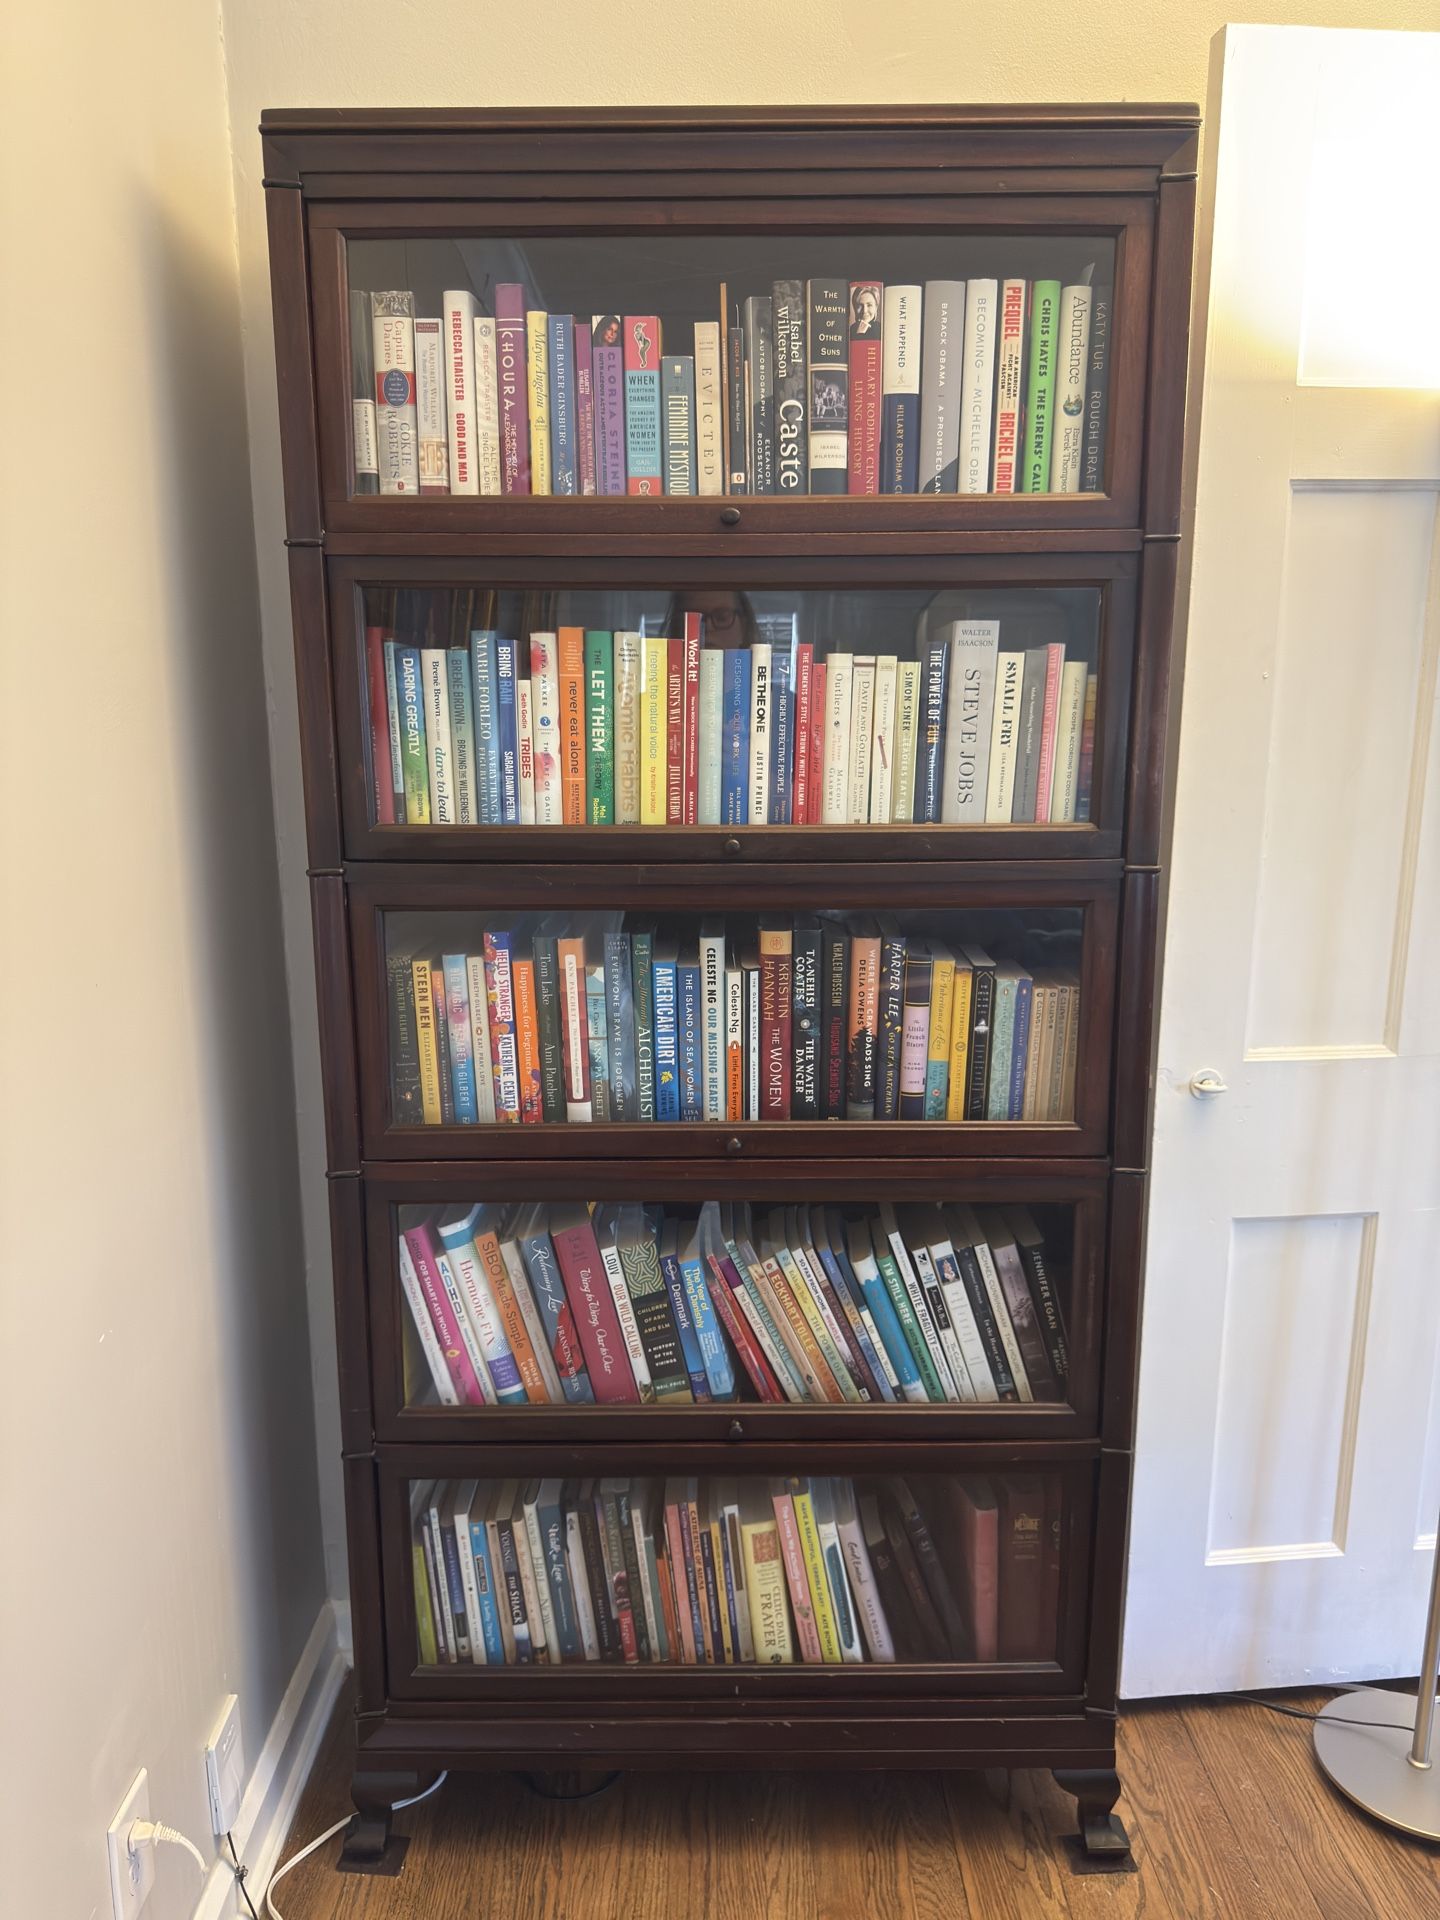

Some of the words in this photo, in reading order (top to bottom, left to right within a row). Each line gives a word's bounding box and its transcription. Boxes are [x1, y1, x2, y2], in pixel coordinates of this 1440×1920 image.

[815, 305, 846, 313] WARMTH
[824, 290, 838, 299] THE
[940, 303, 948, 344] BARACK
[1004, 287, 1022, 340] PREQUEL
[1041, 299, 1051, 335] CHRIS
[1096, 302, 1107, 335] KATY
[383, 322, 392, 365] Dames
[394, 320, 406, 365] Capital
[452, 311, 463, 354] REBECCA
[556, 323, 564, 349] RUTH
[778, 305, 789, 379] Wilkerson
[791, 320, 802, 364] Isabel
[819, 333, 842, 341] OTHER
[898, 325, 906, 368] HAPPENED
[975, 298, 986, 369] BECOMING
[1069, 296, 1087, 384] Abundance
[502, 331, 515, 410] CHOURA
[557, 354, 565, 388] BADER
[1039, 340, 1049, 377] HAYES
[1093, 343, 1104, 370] TUR
[454, 356, 464, 401] TRAISTER
[456, 413, 465, 438] GOOD
[558, 392, 566, 445] GINSBURG
[668, 395, 689, 446] FEMININE
[701, 368, 715, 476] EVICTED
[971, 389, 982, 452] MICHELLE
[1089, 391, 1101, 440] ROUGH
[387, 411, 400, 479] ROBERTS
[400, 422, 412, 467] COKIE
[457, 441, 467, 459] AND
[779, 399, 804, 488] Caste
[458, 462, 468, 483] MAD
[1086, 446, 1097, 491] DRAFT
[476, 638, 489, 683] MARIE
[689, 639, 698, 667] Work
[930, 649, 943, 668] THE
[403, 658, 417, 702] DARING
[592, 670, 604, 699] LET
[688, 670, 697, 682] It!
[757, 666, 766, 683] BE
[904, 672, 913, 701] SIMON
[928, 672, 942, 705] POWER
[1002, 661, 1017, 715] SMALL
[479, 686, 491, 740] FORLEO
[569, 681, 578, 715] never
[757, 684, 765, 707] THE
[778, 696, 787, 723] HIGHLY
[960, 669, 981, 743] STEVE
[405, 705, 419, 756] GREATLY
[570, 718, 579, 736] eat
[592, 705, 605, 752] THEM
[756, 709, 765, 733] ONE
[903, 705, 911, 731] SINEK
[928, 709, 940, 720] OF
[778, 725, 786, 763] EFFECTIVE
[927, 725, 939, 744] FUN
[1000, 719, 1012, 748] FRY
[435, 747, 446, 778] dare
[521, 737, 531, 779] TRIBES
[571, 741, 581, 774] alone
[594, 757, 602, 789] THEORY
[438, 781, 446, 791] to
[777, 764, 786, 792] PEOPLE
[957, 752, 975, 804] JOBS
[438, 794, 450, 823] lead
[540, 954, 551, 977] Tom
[707, 948, 716, 986] CELESTE
[796, 957, 805, 1000] COATES
[806, 950, 815, 1007] TA-NEHISI
[868, 950, 876, 983] WHERE
[890, 943, 902, 989] HARPER
[416, 966, 430, 1002] STERN
[520, 967, 532, 1013] Happiness
[542, 981, 552, 1005] Lake
[656, 967, 674, 1032] AMERICAN
[707, 989, 716, 1003] NG
[764, 960, 774, 1020] HANNAH
[778, 963, 788, 1018] KRISTIN
[866, 987, 874, 1005] THE
[420, 1006, 431, 1029] MEN
[523, 1015, 532, 1029] for
[708, 1008, 717, 1028] OUR
[888, 997, 900, 1017] LEE
[657, 1037, 675, 1065] DIRT
[687, 1031, 693, 1043] OF
[708, 1032, 717, 1073] MISSING
[772, 1028, 780, 1044] THE
[806, 1039, 814, 1060] THE
[865, 1009, 874, 1061] CRAWDADS
[523, 1031, 534, 1075] Beginners
[544, 1042, 555, 1064] Ann
[546, 1067, 558, 1108] Patchett
[638, 1026, 652, 1121] ALCHEMIST
[769, 1047, 782, 1107] WOMEN
[796, 1049, 804, 1093] DANCER
[805, 1064, 814, 1103] WATER
[864, 1065, 872, 1087] SING
[709, 1077, 718, 1113] HEARTS
[605, 1253, 619, 1275] LOUV
[693, 1266, 701, 1282] The
[883, 1262, 892, 1276] I'M
[482, 1240, 498, 1276] SIBO
[495, 1280, 508, 1305] Made
[507, 1308, 523, 1349] Simple
[614, 1284, 626, 1301] OUR
[671, 1283, 690, 1329] Denmark
[684, 1269, 695, 1294] Living
[690, 1295, 704, 1329] Danishly
[696, 1284, 705, 1301] Year
[698, 1303, 708, 1311] of
[887, 1279, 902, 1301] STILL
[1032, 1251, 1050, 1298] JENNIFER
[1044, 1302, 1056, 1329] EGAN
[618, 1303, 632, 1324] WILD
[898, 1303, 912, 1325] HERE
[908, 1282, 923, 1308] WHITE
[918, 1310, 937, 1346] FRAGILITY
[624, 1326, 641, 1359] CALLING
[501, 1530, 512, 1562] YOUNG
[510, 1591, 522, 1624] SHACK
[696, 1556, 702, 1565] OF
[760, 1593, 775, 1648] PRAYER
